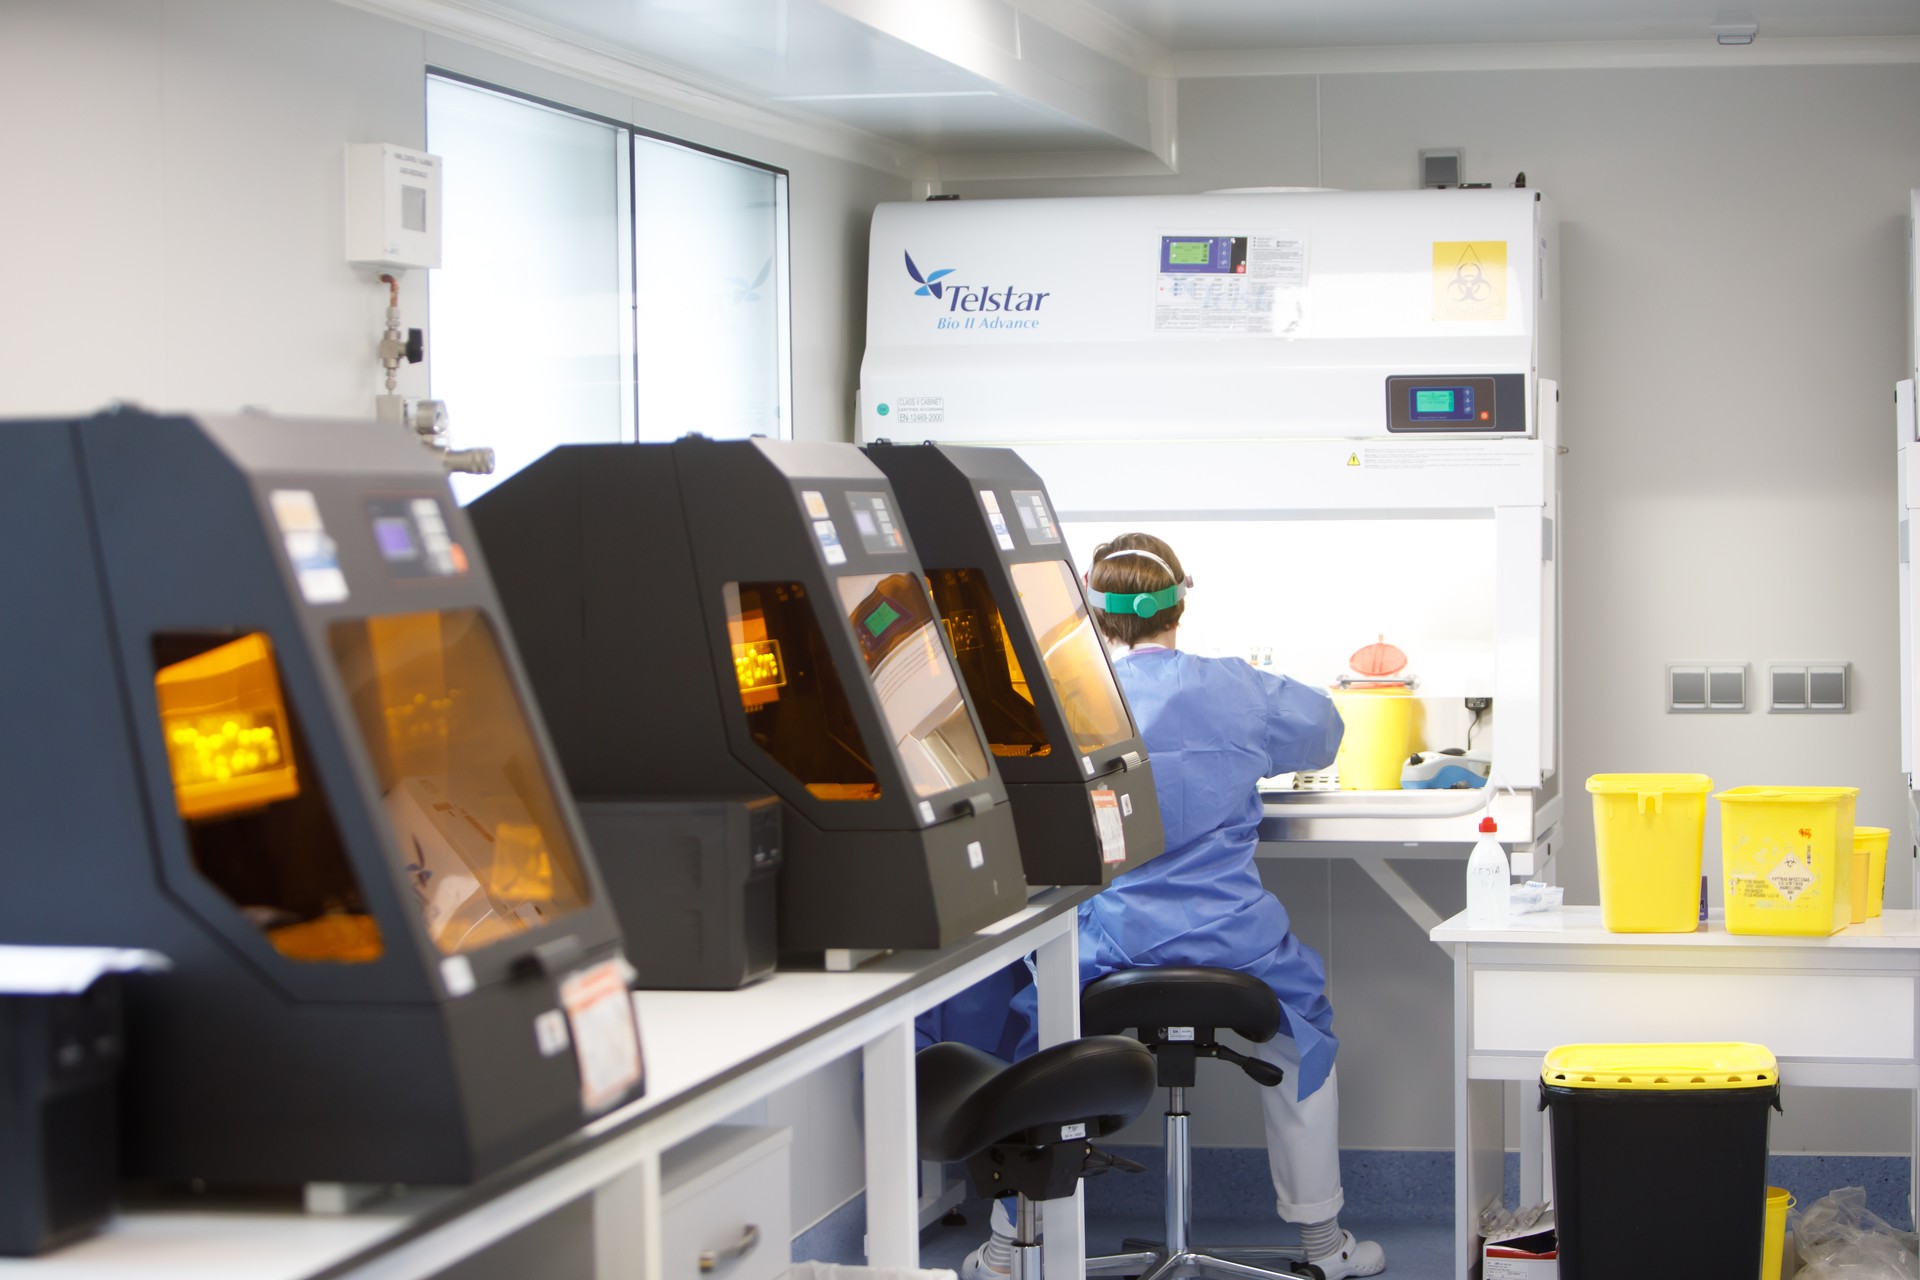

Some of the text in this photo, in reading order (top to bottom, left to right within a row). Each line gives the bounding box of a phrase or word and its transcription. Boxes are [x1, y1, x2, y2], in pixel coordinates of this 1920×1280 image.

[945, 285, 1050, 312] Telstar
[937, 316, 1040, 330] Bio II Advance
